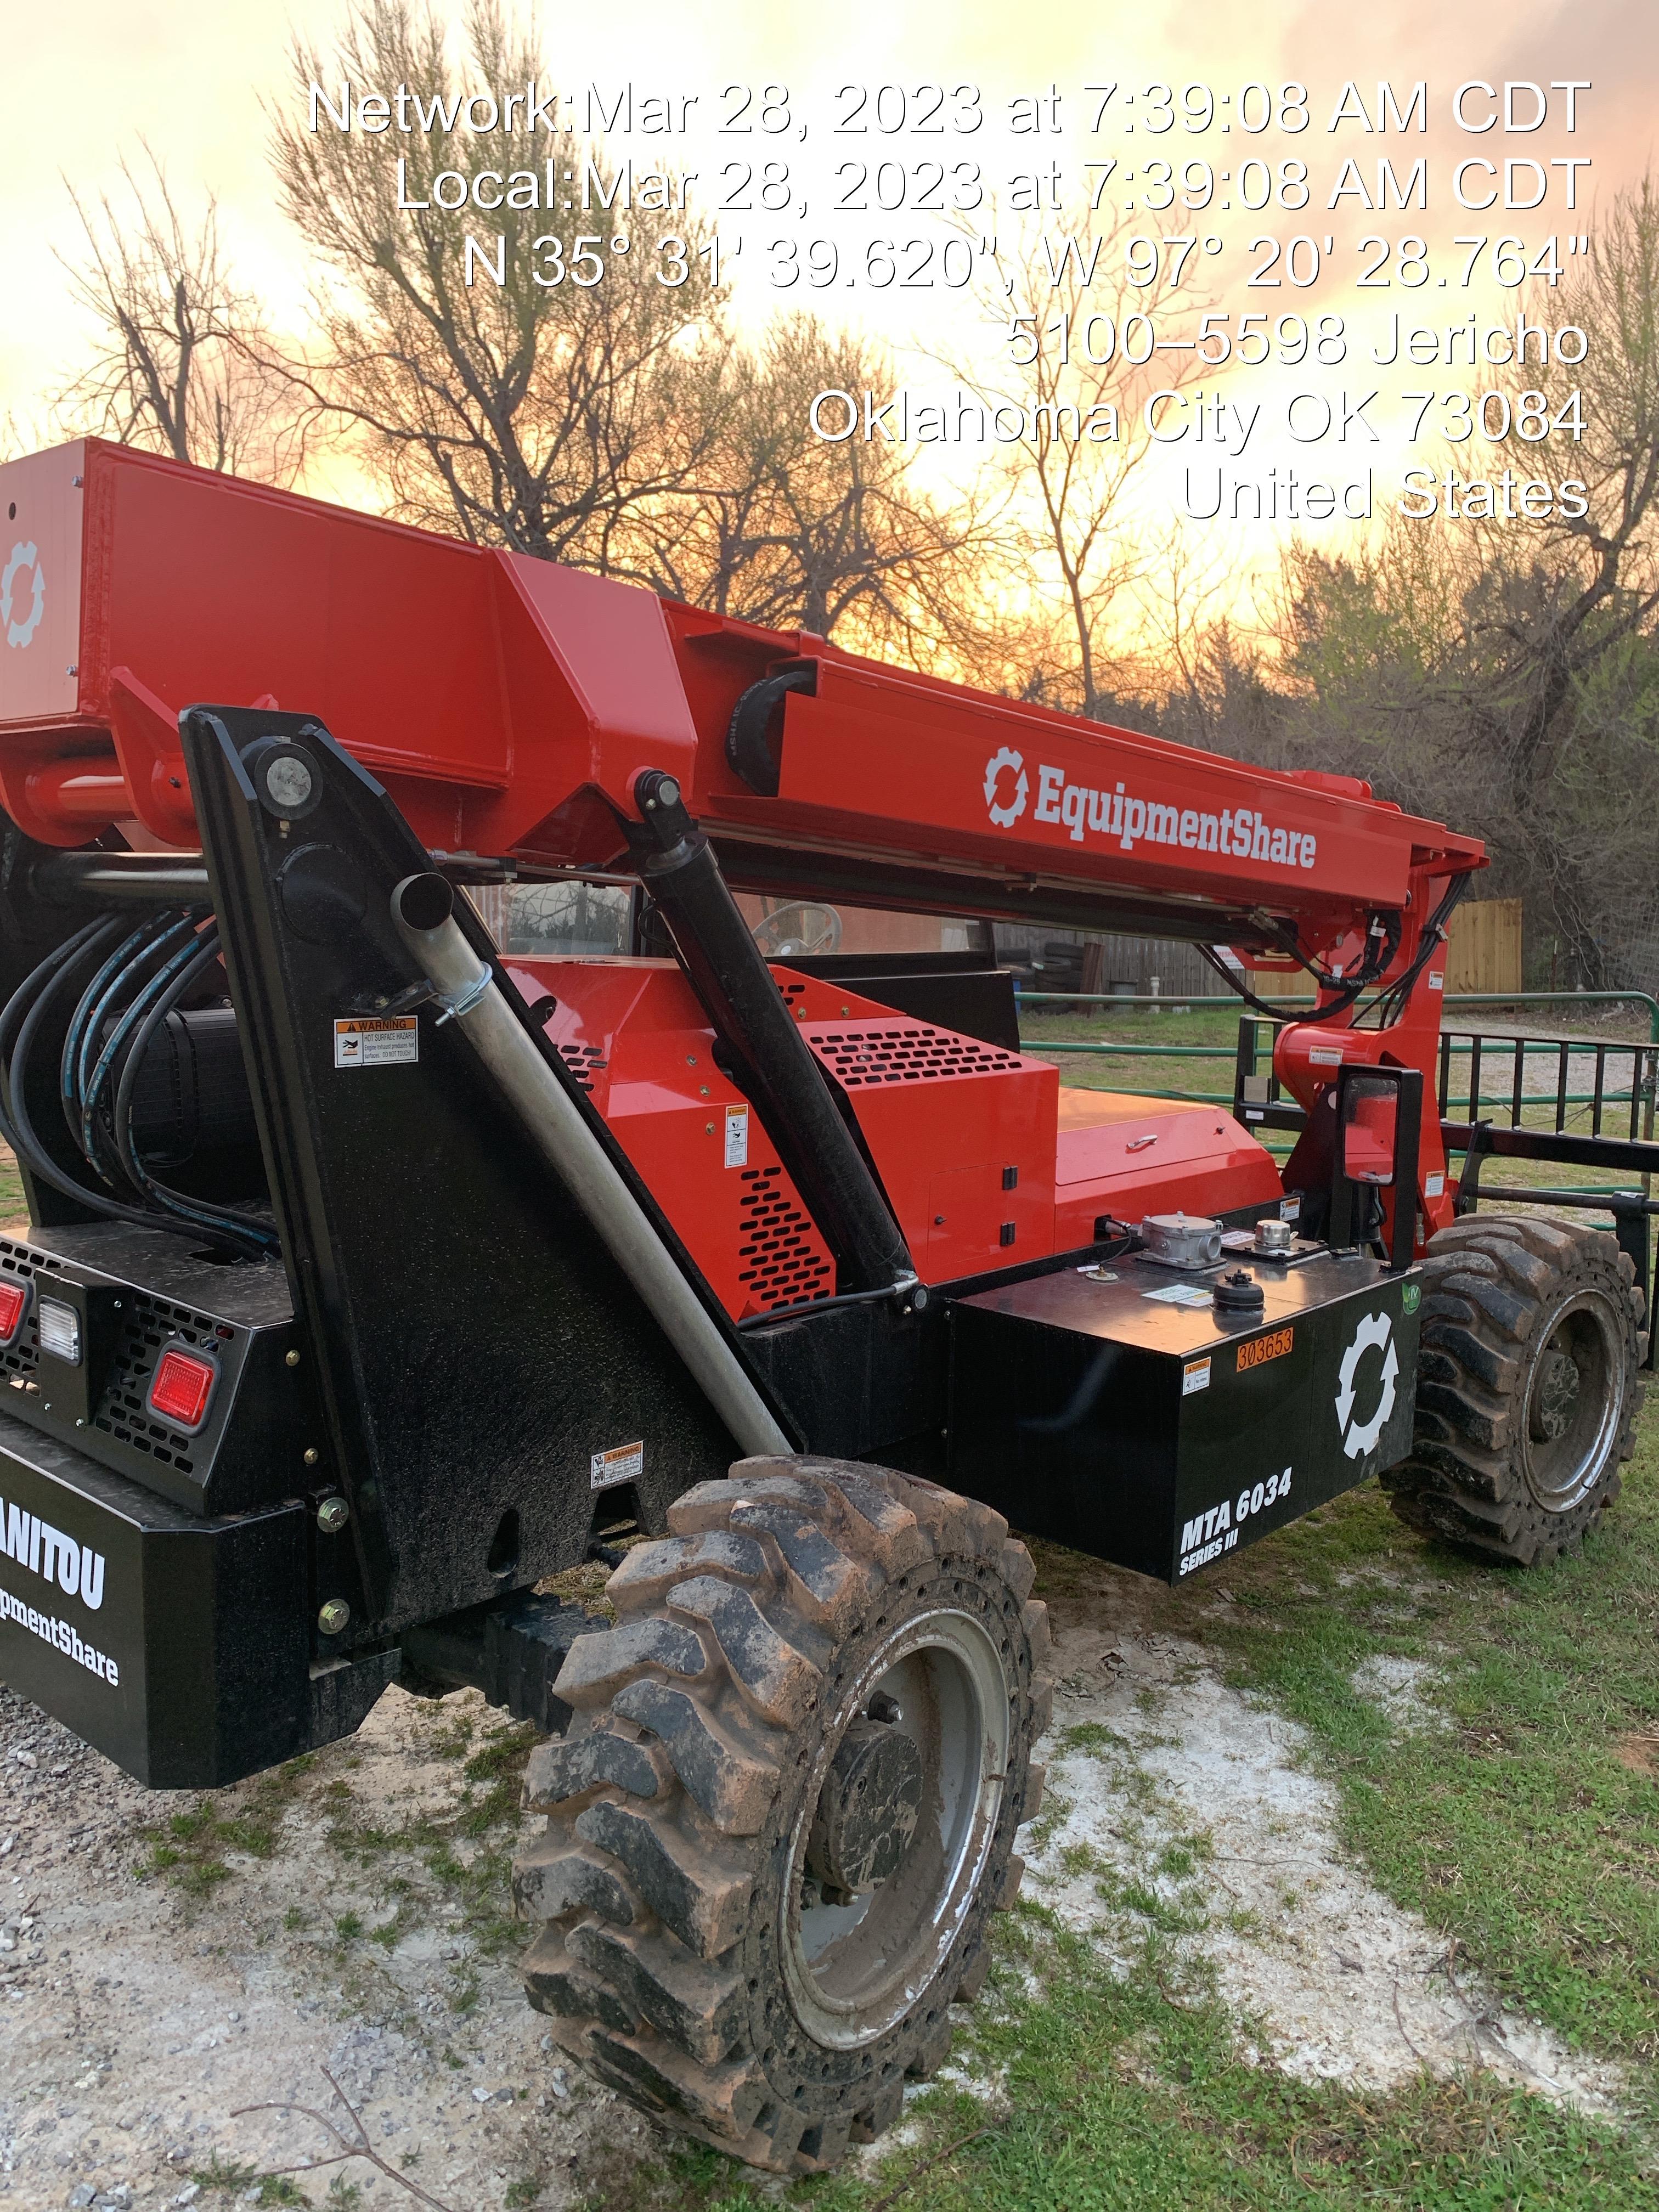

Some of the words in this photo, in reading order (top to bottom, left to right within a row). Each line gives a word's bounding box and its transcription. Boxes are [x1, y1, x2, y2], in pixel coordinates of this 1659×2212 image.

[1034, 765, 1316, 868] EquipmentShare
[359, 1020, 407, 1031] WARNING
[375, 1032, 396, 1041] SURFACE
[397, 1031, 415, 1040] HAZARD
[1238, 1329, 1291, 1369] 303653
[612, 1446, 640, 1459] WARNING
[1180, 1499, 1231, 1555] MTA
[1236, 1466, 1293, 1522] 6034
[1180, 1537, 1223, 1571] SERIES
[1224, 1527, 1239, 1551] III
